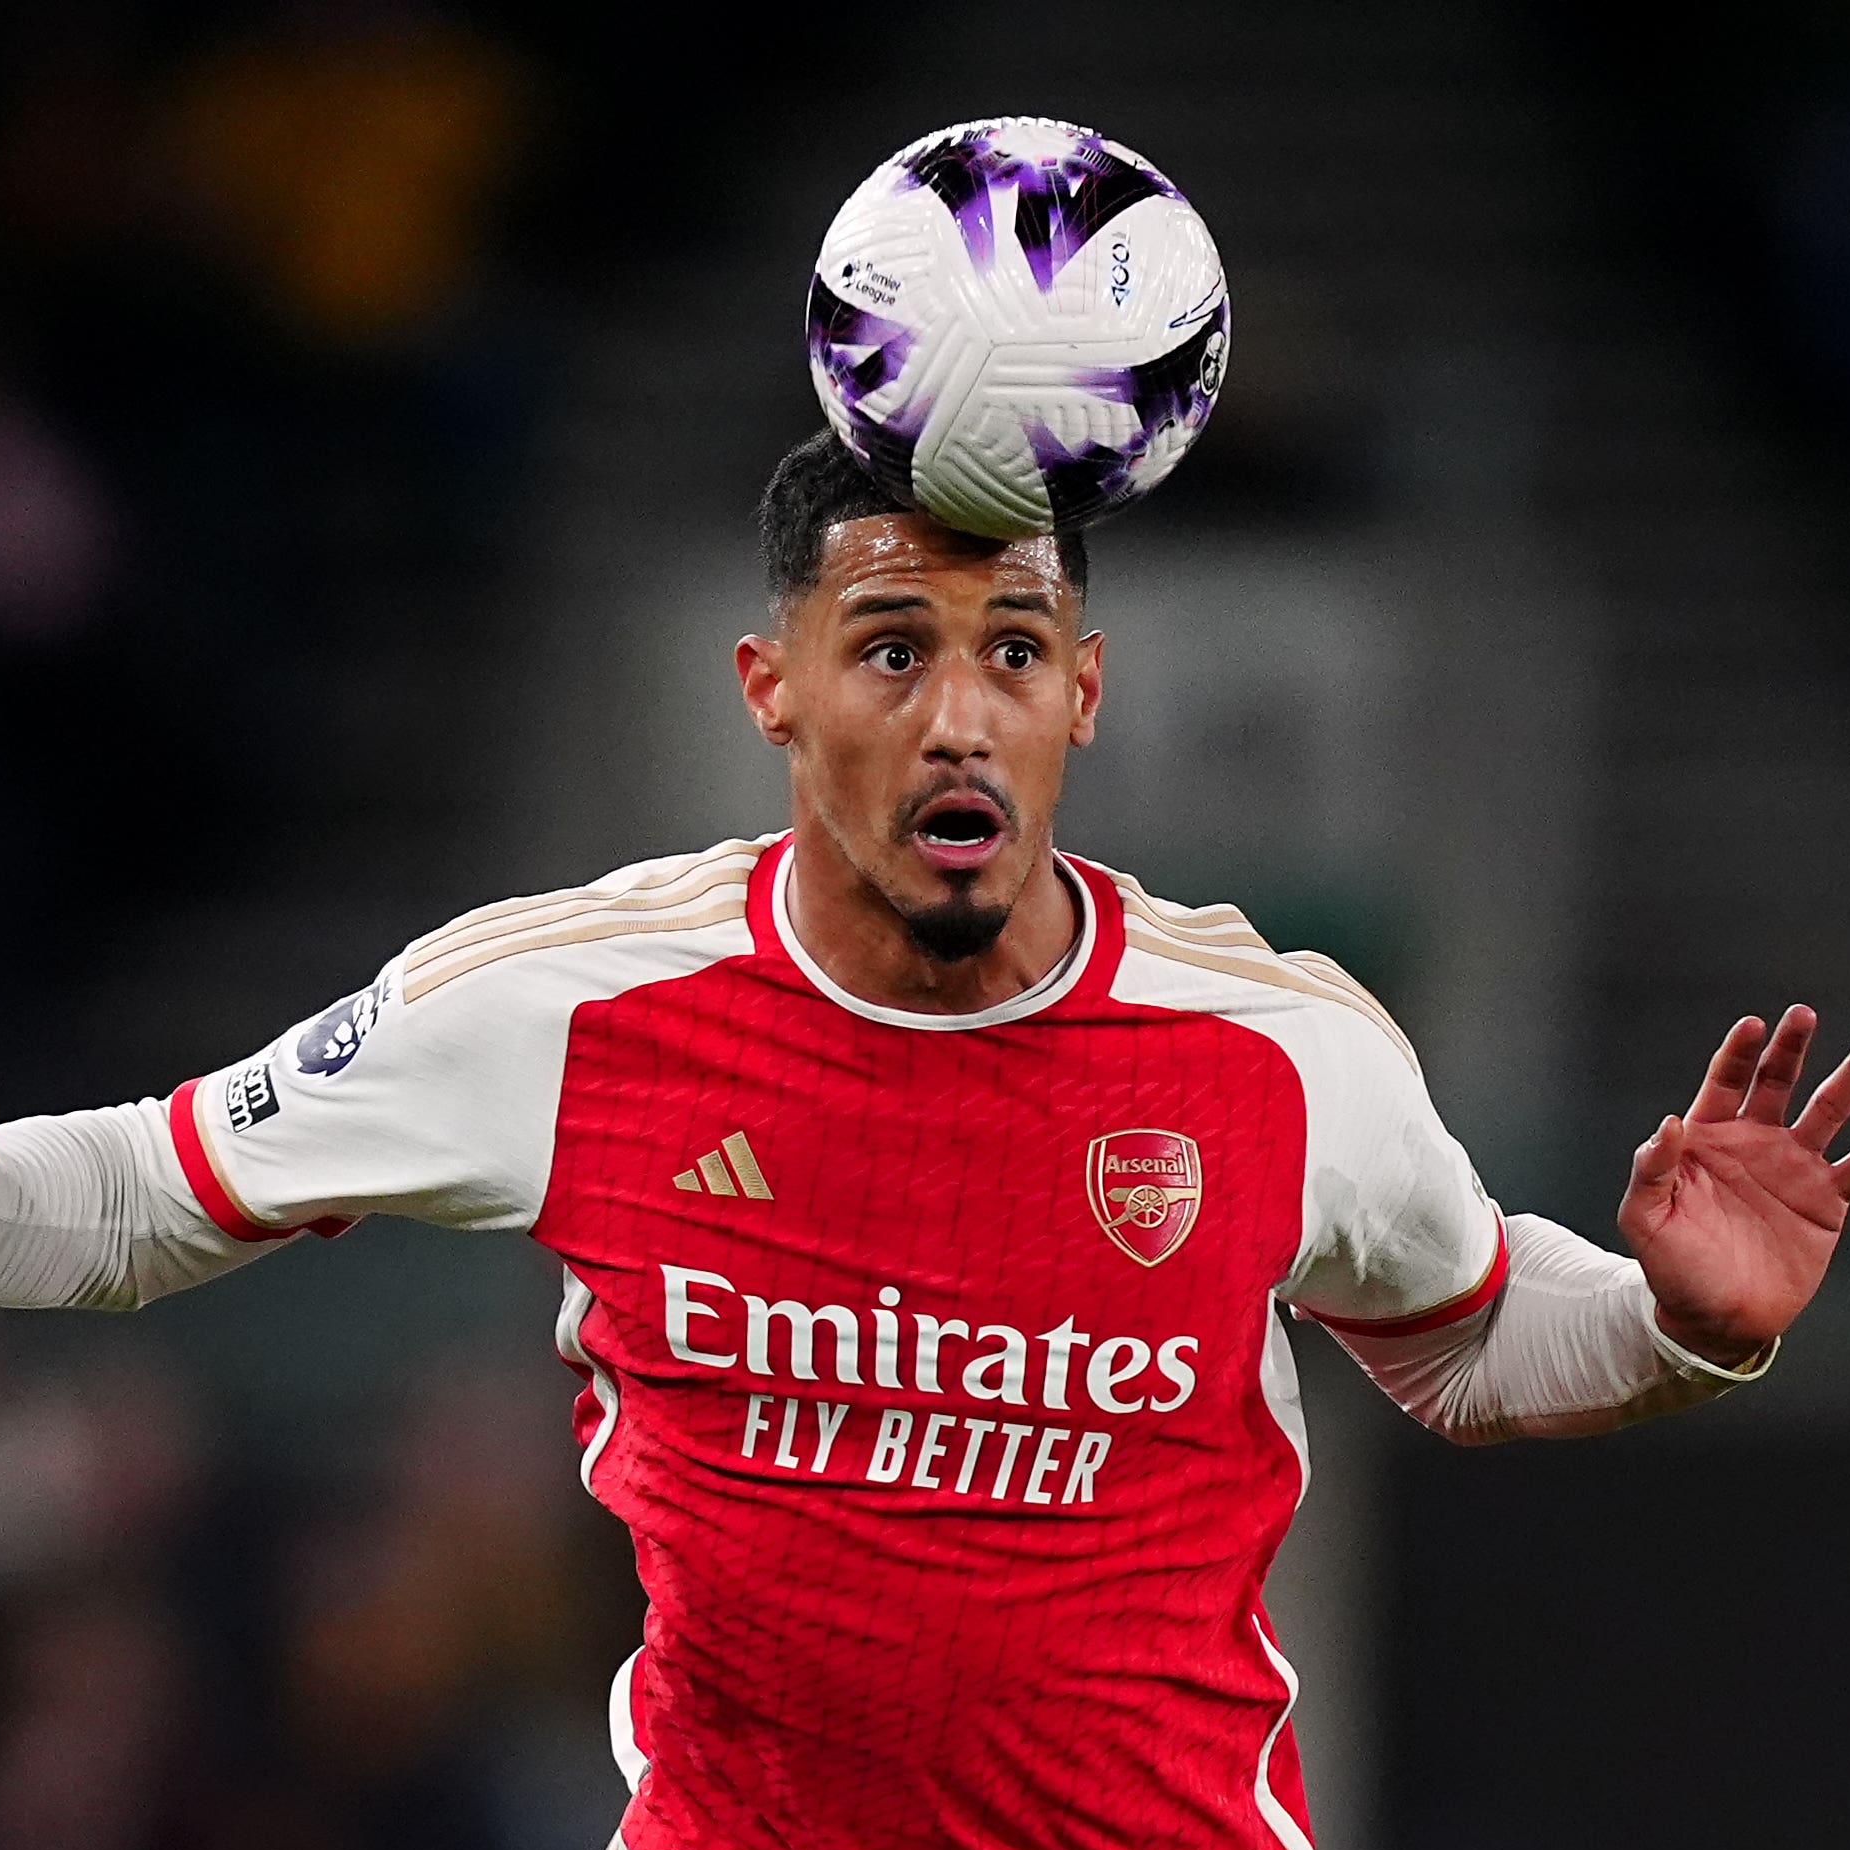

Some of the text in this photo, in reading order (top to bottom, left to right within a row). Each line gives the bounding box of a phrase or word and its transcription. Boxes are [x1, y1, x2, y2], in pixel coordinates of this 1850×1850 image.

[855, 279, 896, 306] League
[1104, 1154, 1186, 1175] Arsenal
[659, 1263, 1200, 1414] Emirates
[740, 1394, 1113, 1505] FLY BETTER
